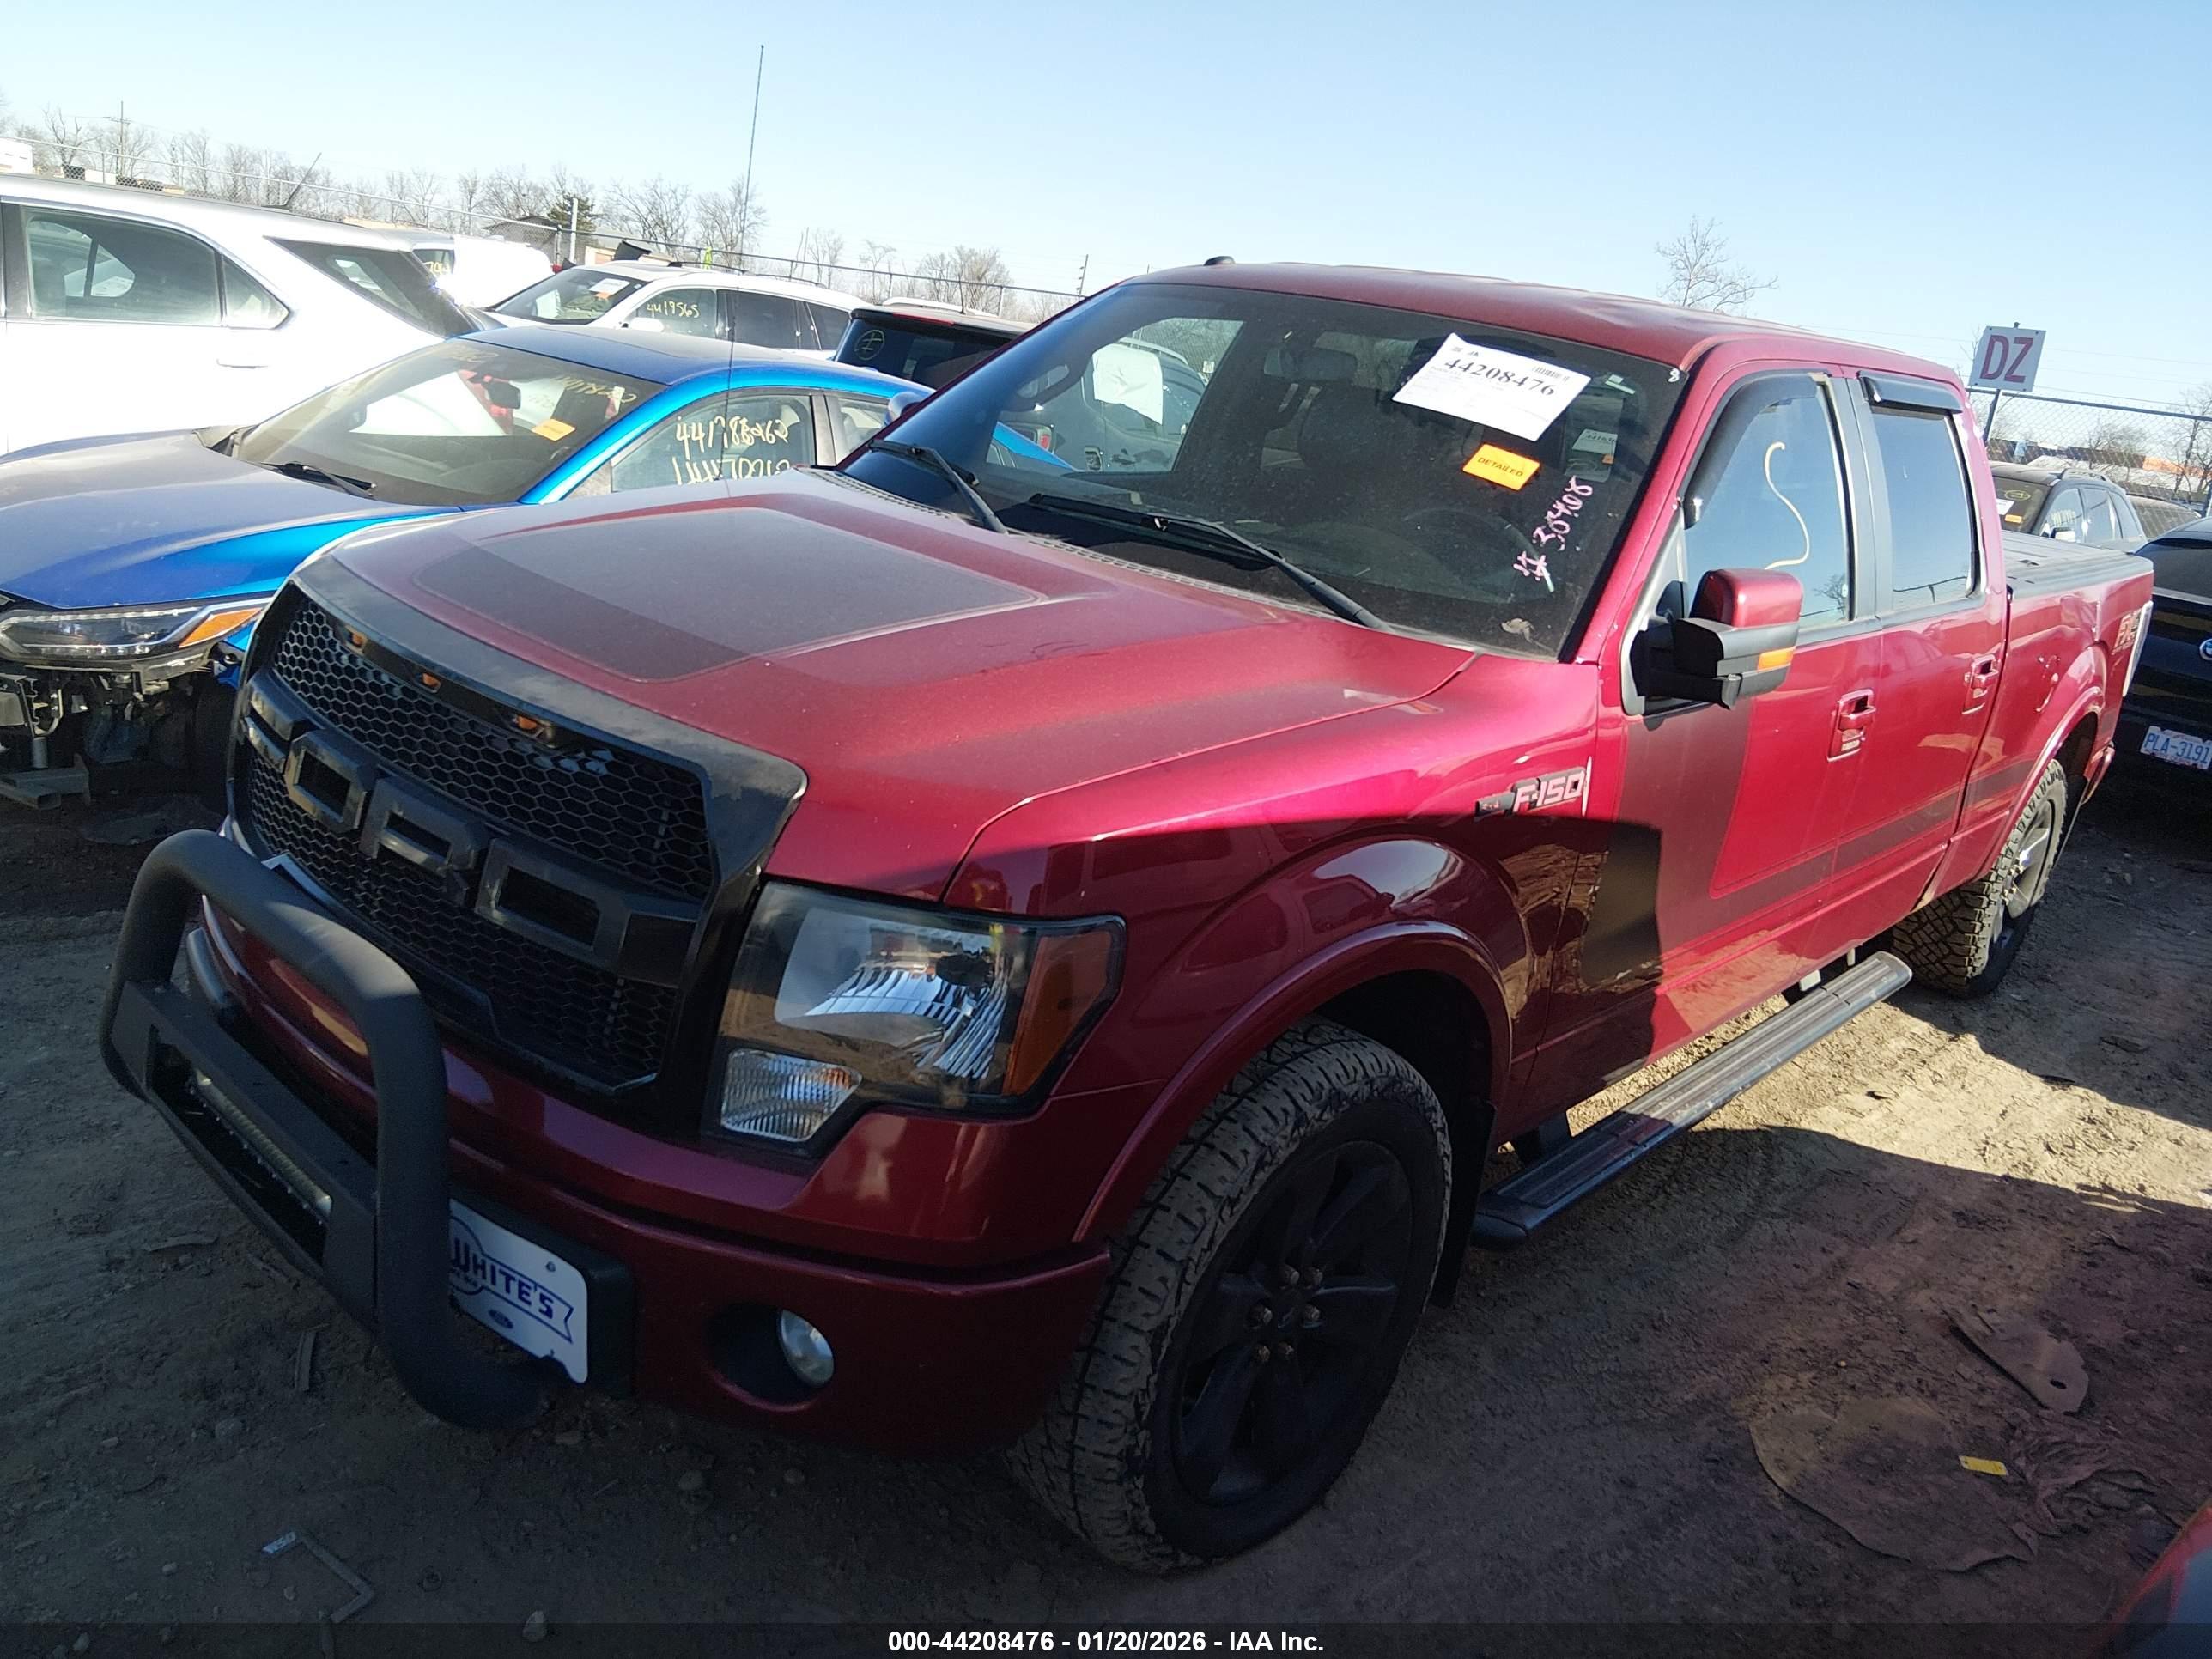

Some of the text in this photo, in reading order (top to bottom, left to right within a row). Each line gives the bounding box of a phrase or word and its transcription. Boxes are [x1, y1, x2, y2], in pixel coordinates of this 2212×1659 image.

[1444, 358, 1555, 396] 44208476
[1979, 335, 2033, 383] DZ
[1477, 457, 1524, 477] DETAILED
[2143, 732, 2209, 764] PLA-3191
[1512, 770, 1586, 813] F-150
